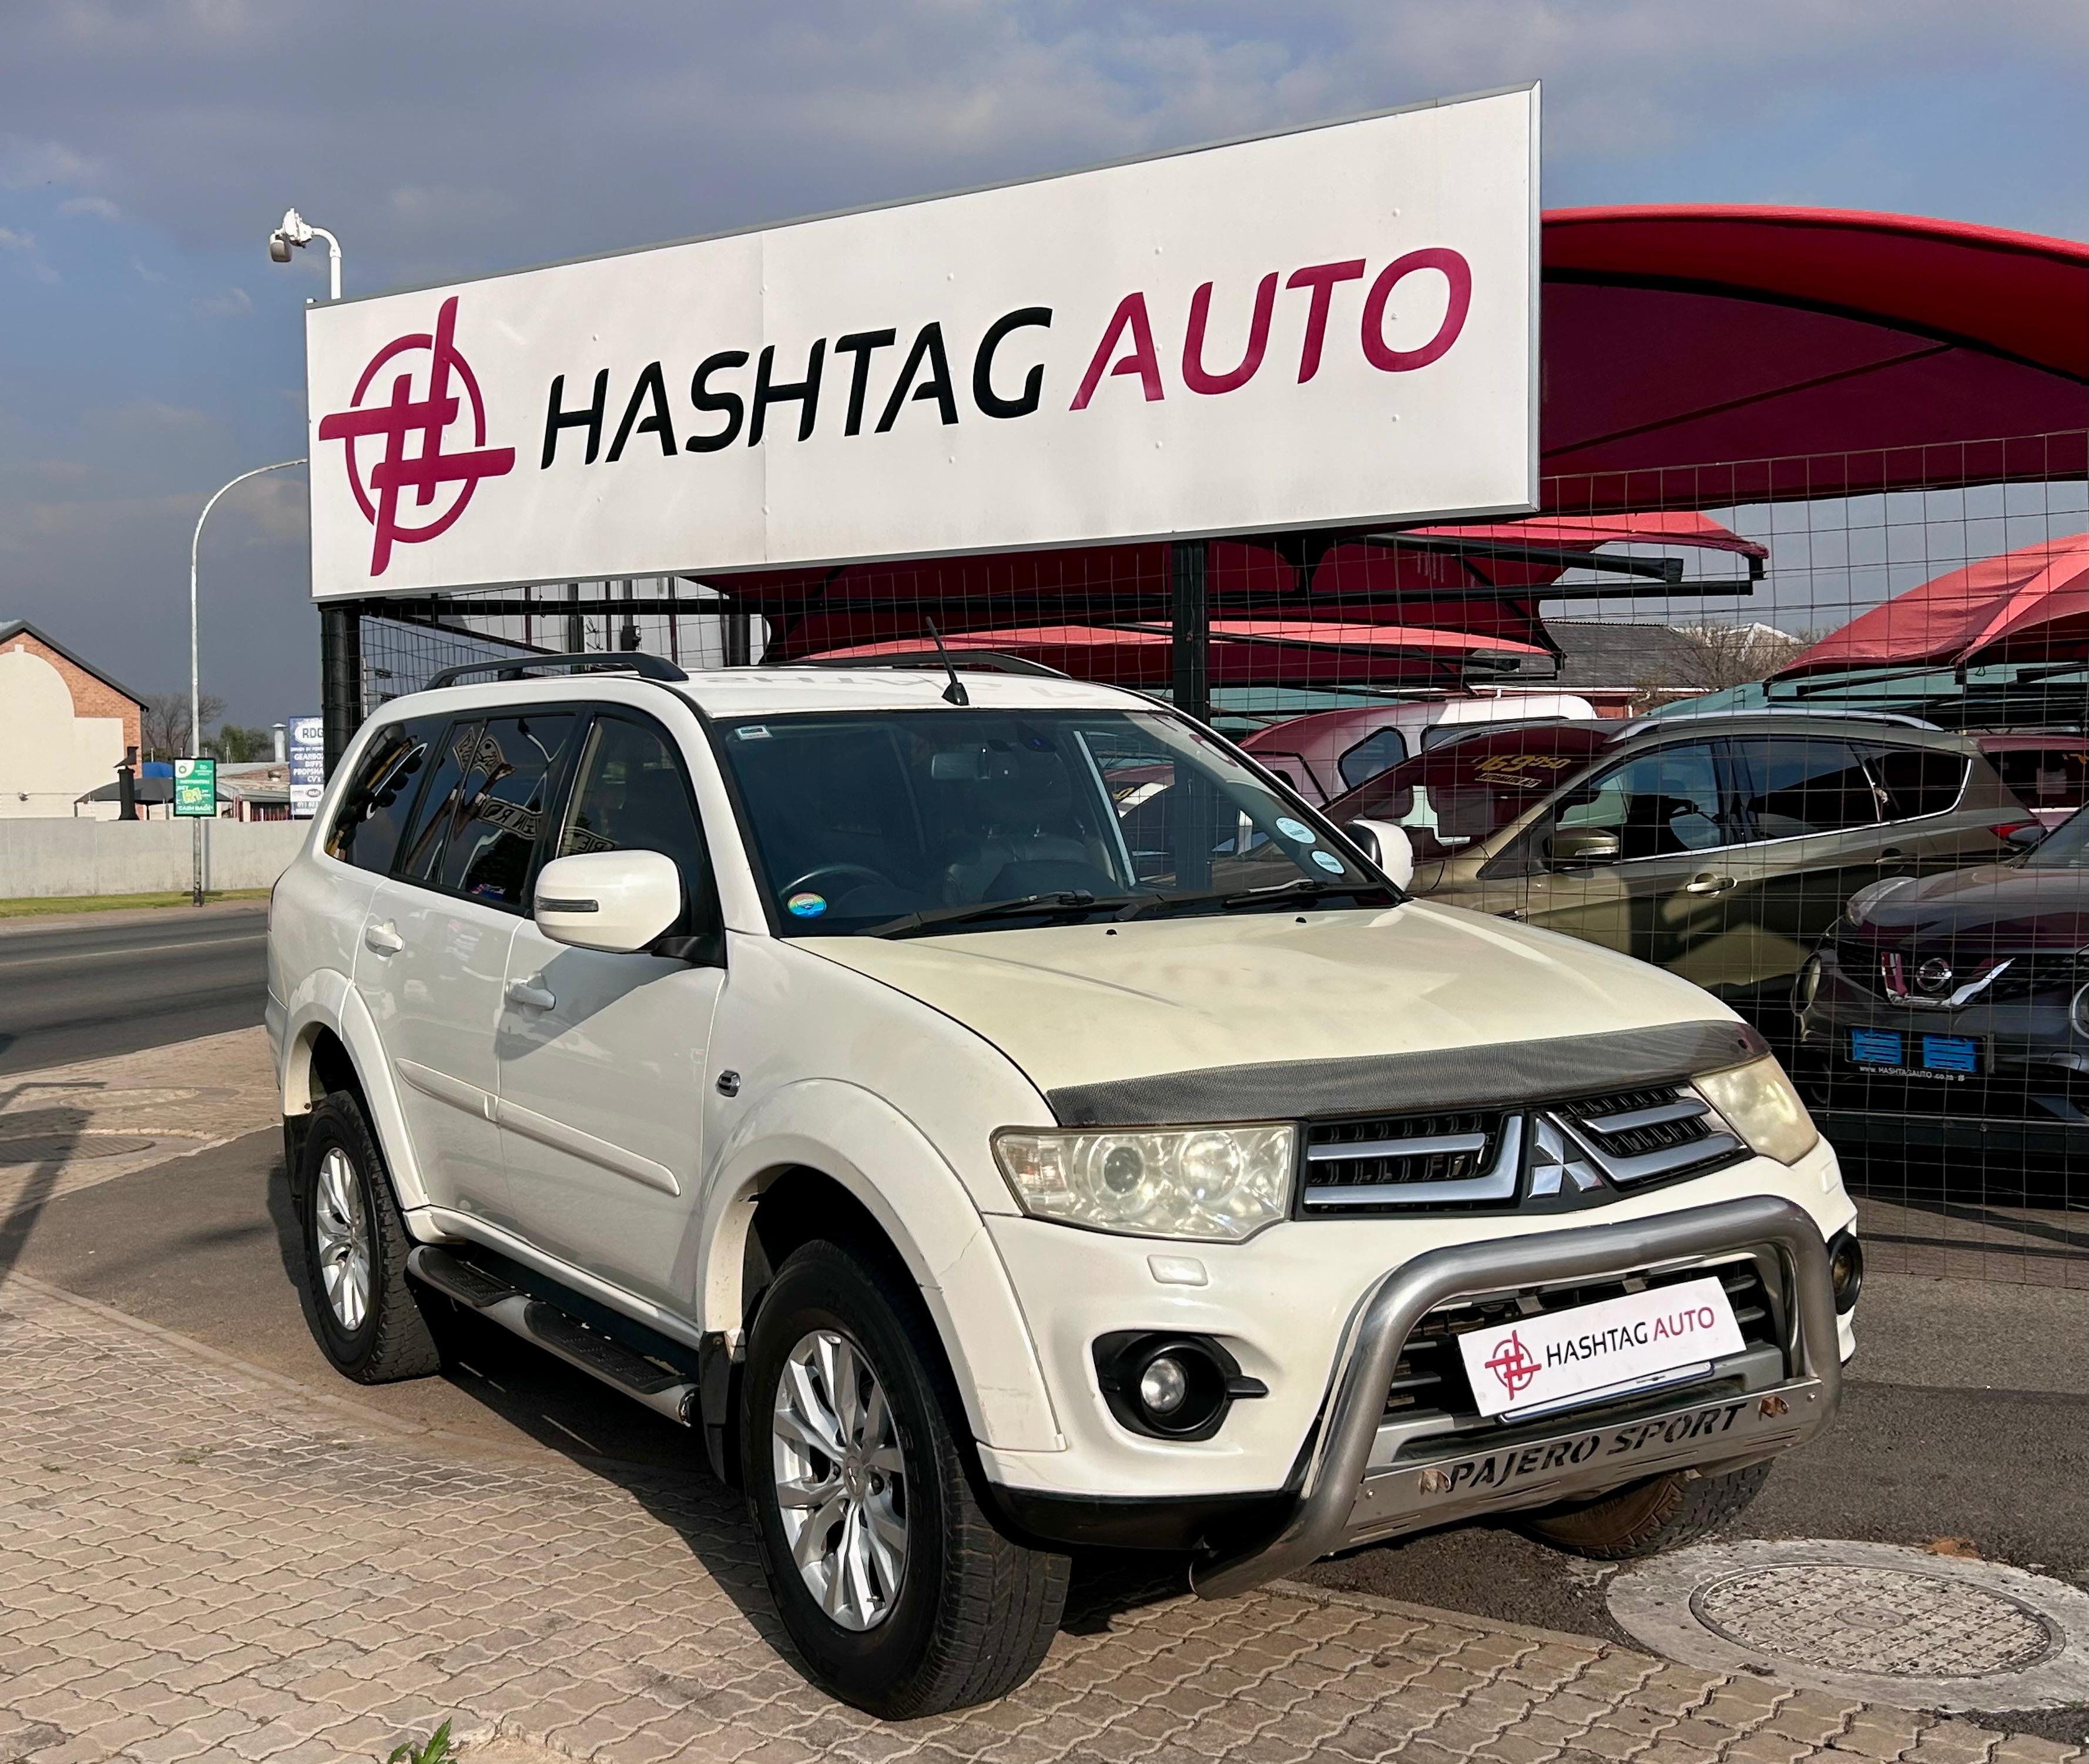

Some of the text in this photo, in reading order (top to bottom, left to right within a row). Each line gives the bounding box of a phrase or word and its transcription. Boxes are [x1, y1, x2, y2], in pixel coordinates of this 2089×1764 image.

[540, 247, 1472, 469] HASHTAG AUTO
[1878, 1067, 1932, 1078] HASHTAGAUTO
[1547, 1306, 1715, 1368] HASHTAG AUTO
[1449, 1402, 1748, 1493] PAJERO SPORT
